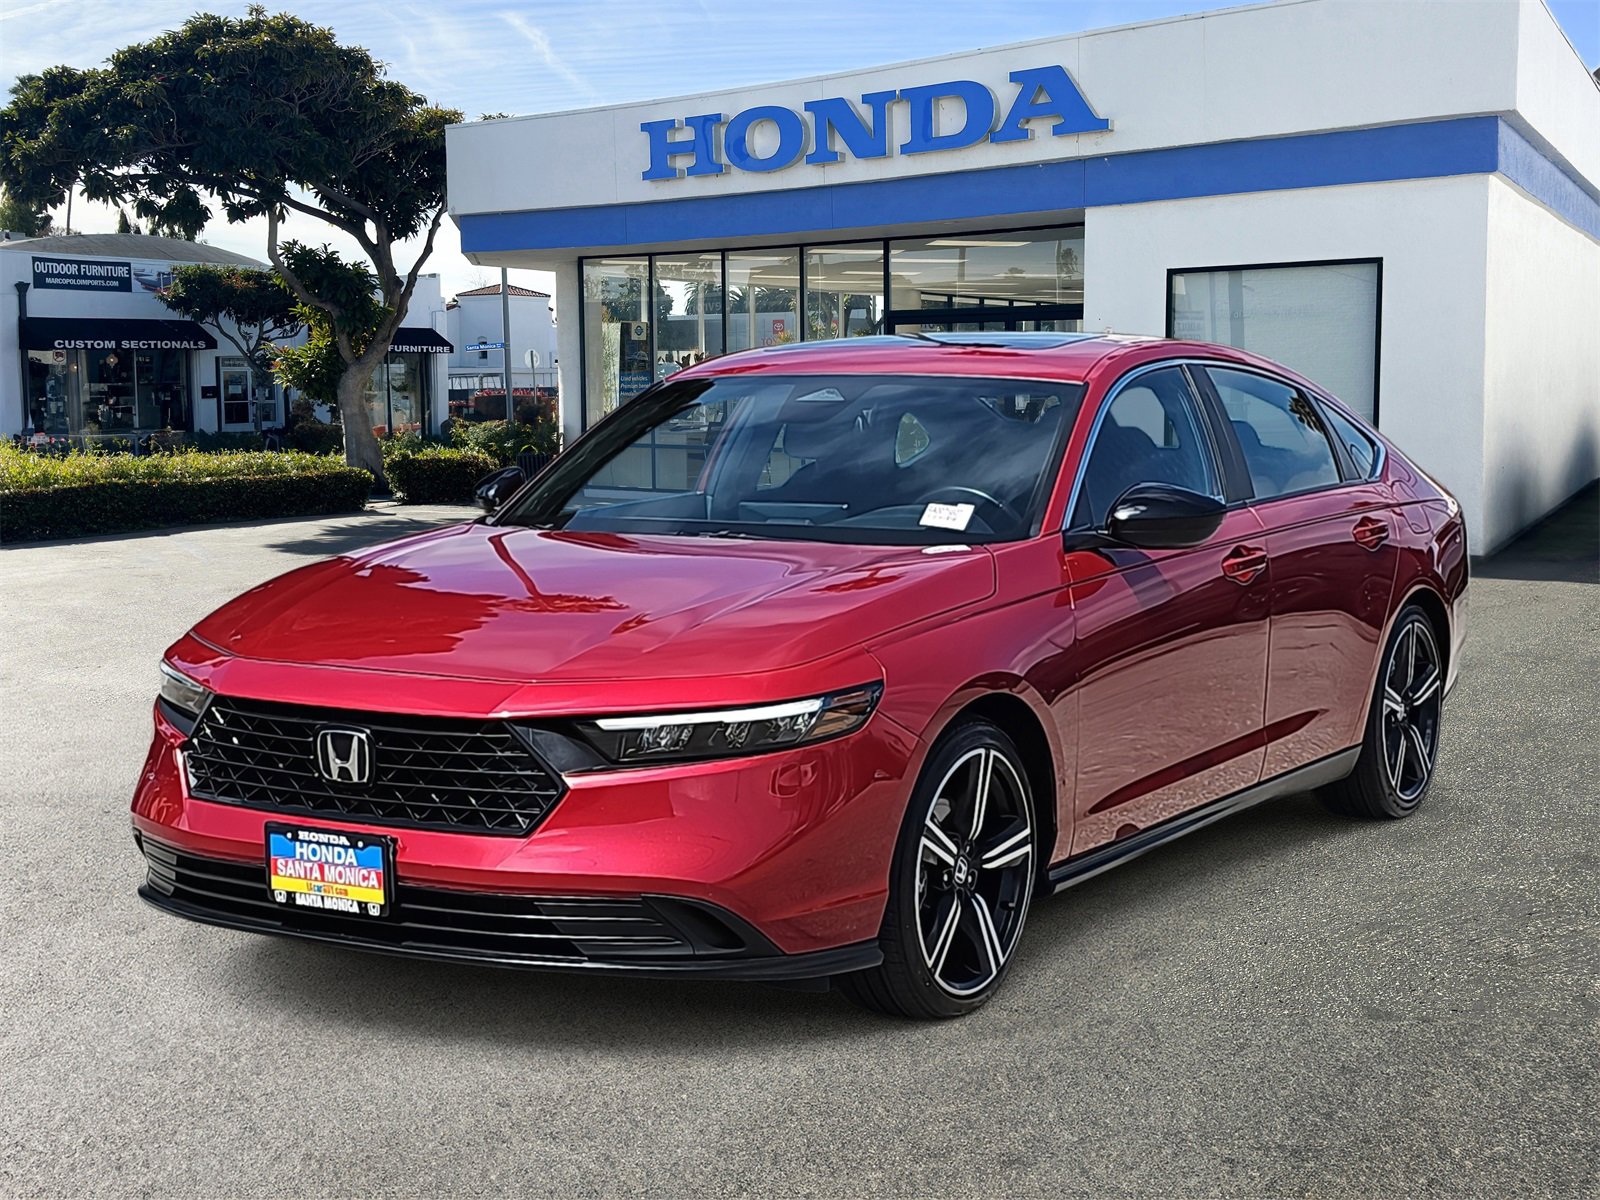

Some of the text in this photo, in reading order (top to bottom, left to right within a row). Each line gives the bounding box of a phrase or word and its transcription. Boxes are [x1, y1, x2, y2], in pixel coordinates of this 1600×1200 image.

[640, 64, 1114, 182] HONDA
[34, 260, 130, 278] OUTDOOR FURNITURE
[45, 277, 119, 287] MARCOPOLOIMPORTS.COM
[53, 339, 207, 349] CUSTOM SECTIONALS
[388, 344, 451, 353] FURNITURE
[298, 830, 350, 846] HONDA
[295, 841, 358, 867] HONDA
[277, 859, 379, 889] SANTA MONICA
[295, 892, 360, 914] SANTA MONICA
